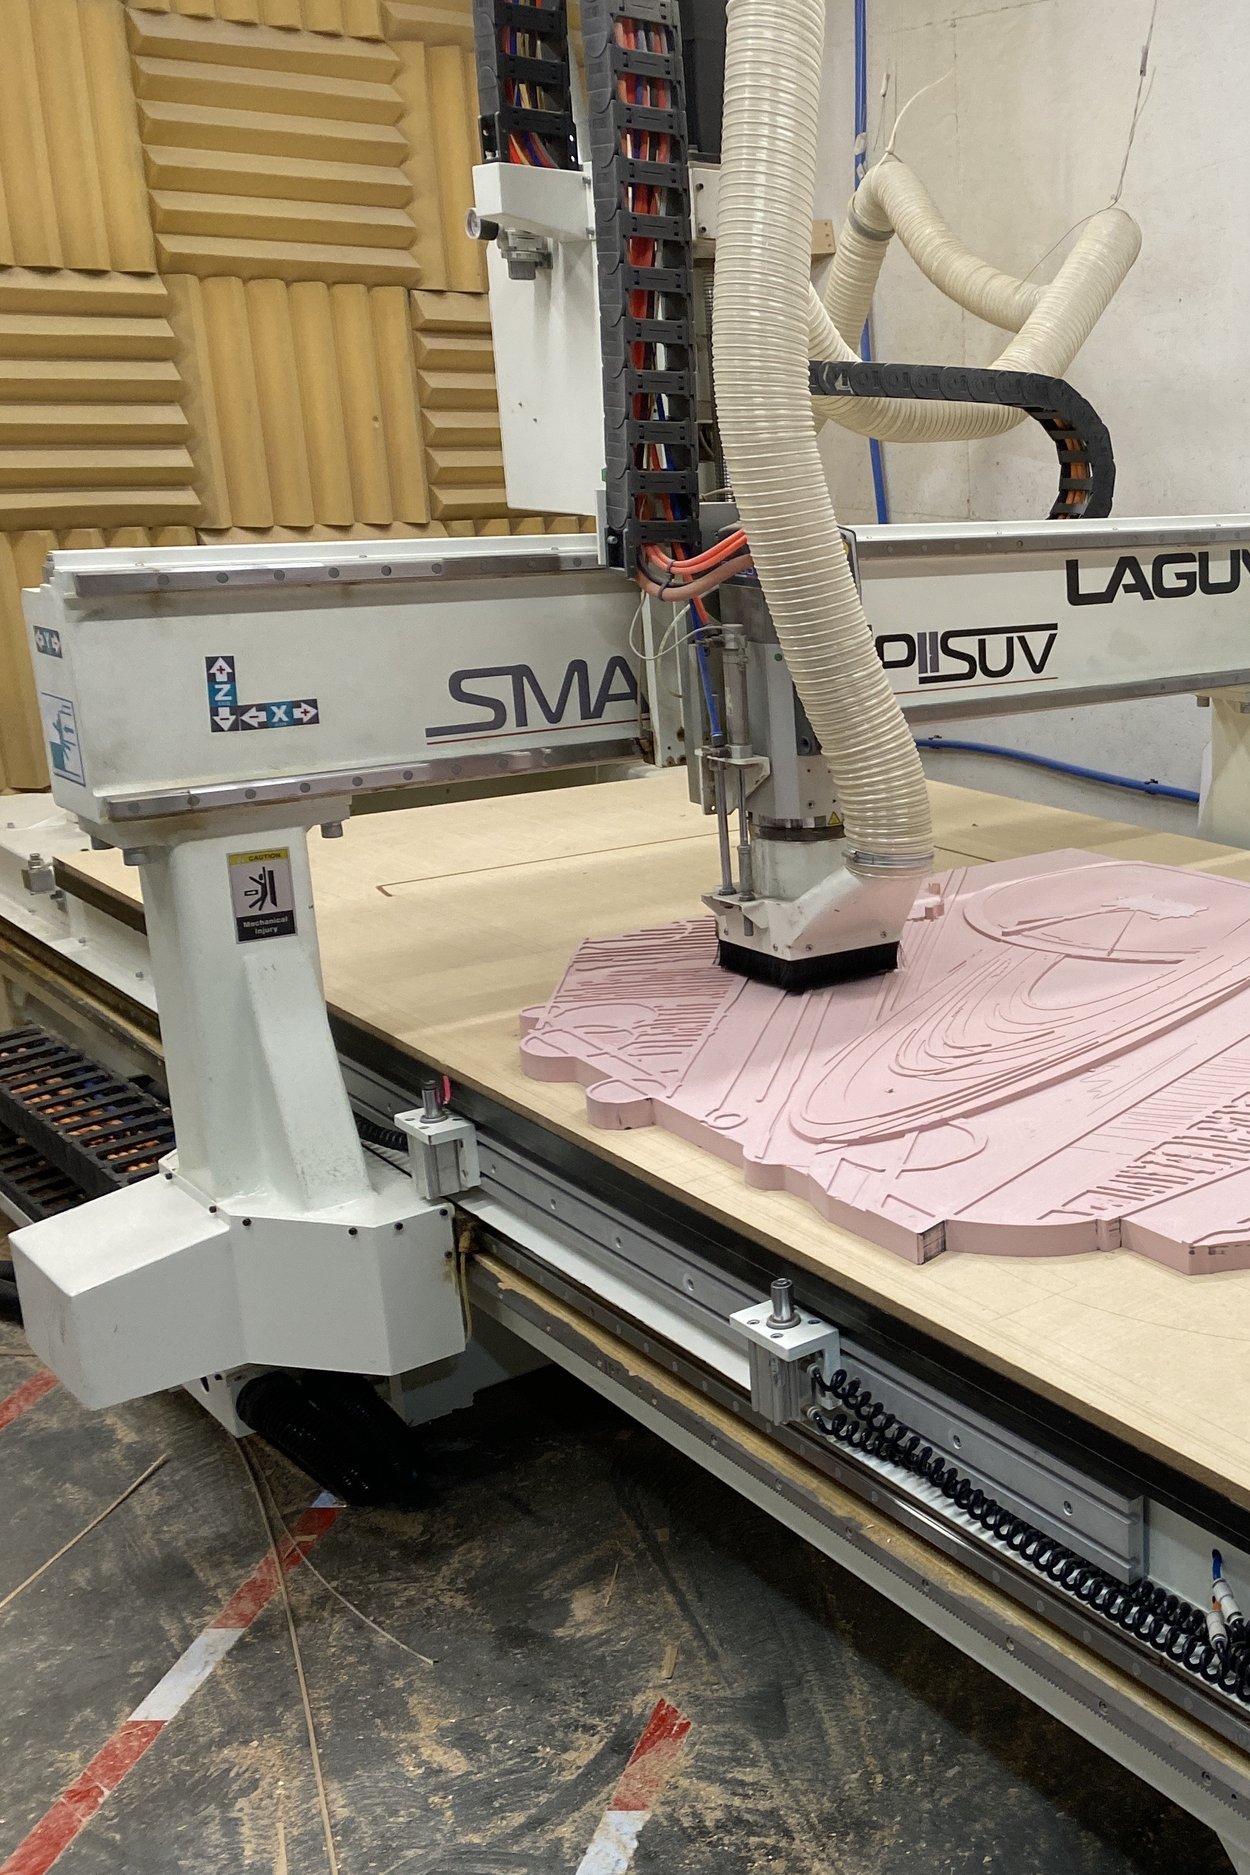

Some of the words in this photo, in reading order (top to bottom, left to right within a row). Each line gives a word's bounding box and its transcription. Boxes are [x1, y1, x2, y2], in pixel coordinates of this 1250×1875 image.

[214, 684, 232, 701] Z
[270, 705, 289, 722] X
[248, 852, 281, 861] CAUTION
[243, 916, 288, 928] Mechanical
[255, 926, 278, 935] Injury
